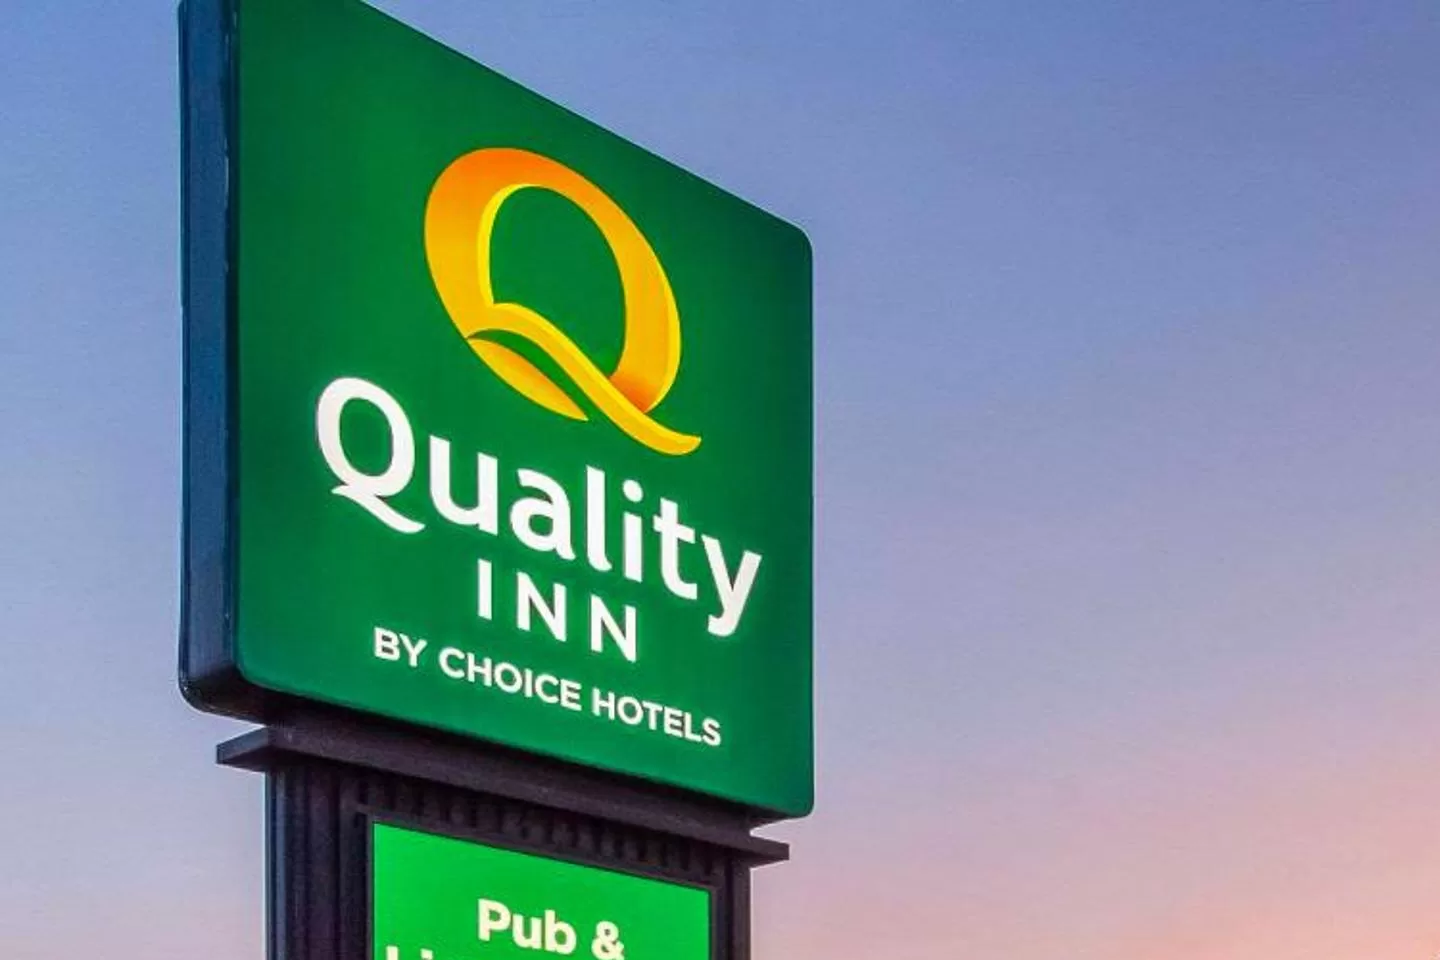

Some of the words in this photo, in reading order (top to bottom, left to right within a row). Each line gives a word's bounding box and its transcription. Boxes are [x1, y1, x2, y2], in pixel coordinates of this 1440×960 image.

[316, 377, 763, 637] Quality
[477, 558, 638, 663] INN
[373, 627, 427, 667] BY
[438, 646, 582, 711] CHOICE
[591, 687, 722, 747] HOTELS
[477, 897, 577, 955] Pub
